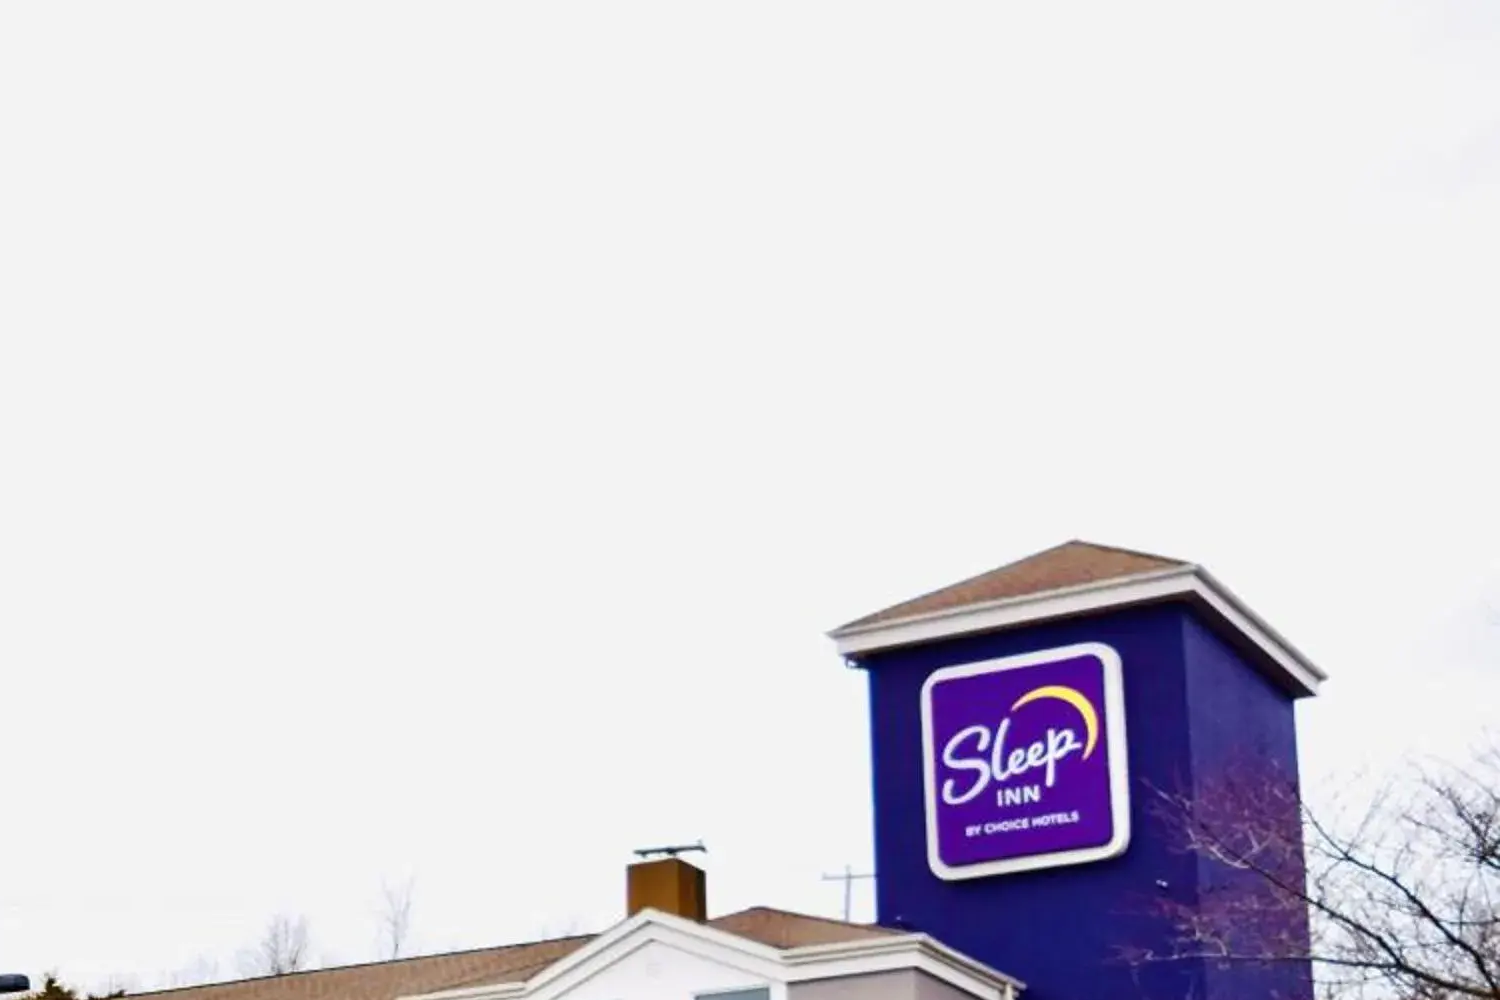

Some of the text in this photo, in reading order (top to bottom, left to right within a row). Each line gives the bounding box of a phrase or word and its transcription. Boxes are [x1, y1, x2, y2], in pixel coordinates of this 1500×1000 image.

[942, 717, 1082, 805] Sleep
[996, 784, 1041, 807] INN
[965, 810, 1079, 837] BY CHOICE HOTELS
